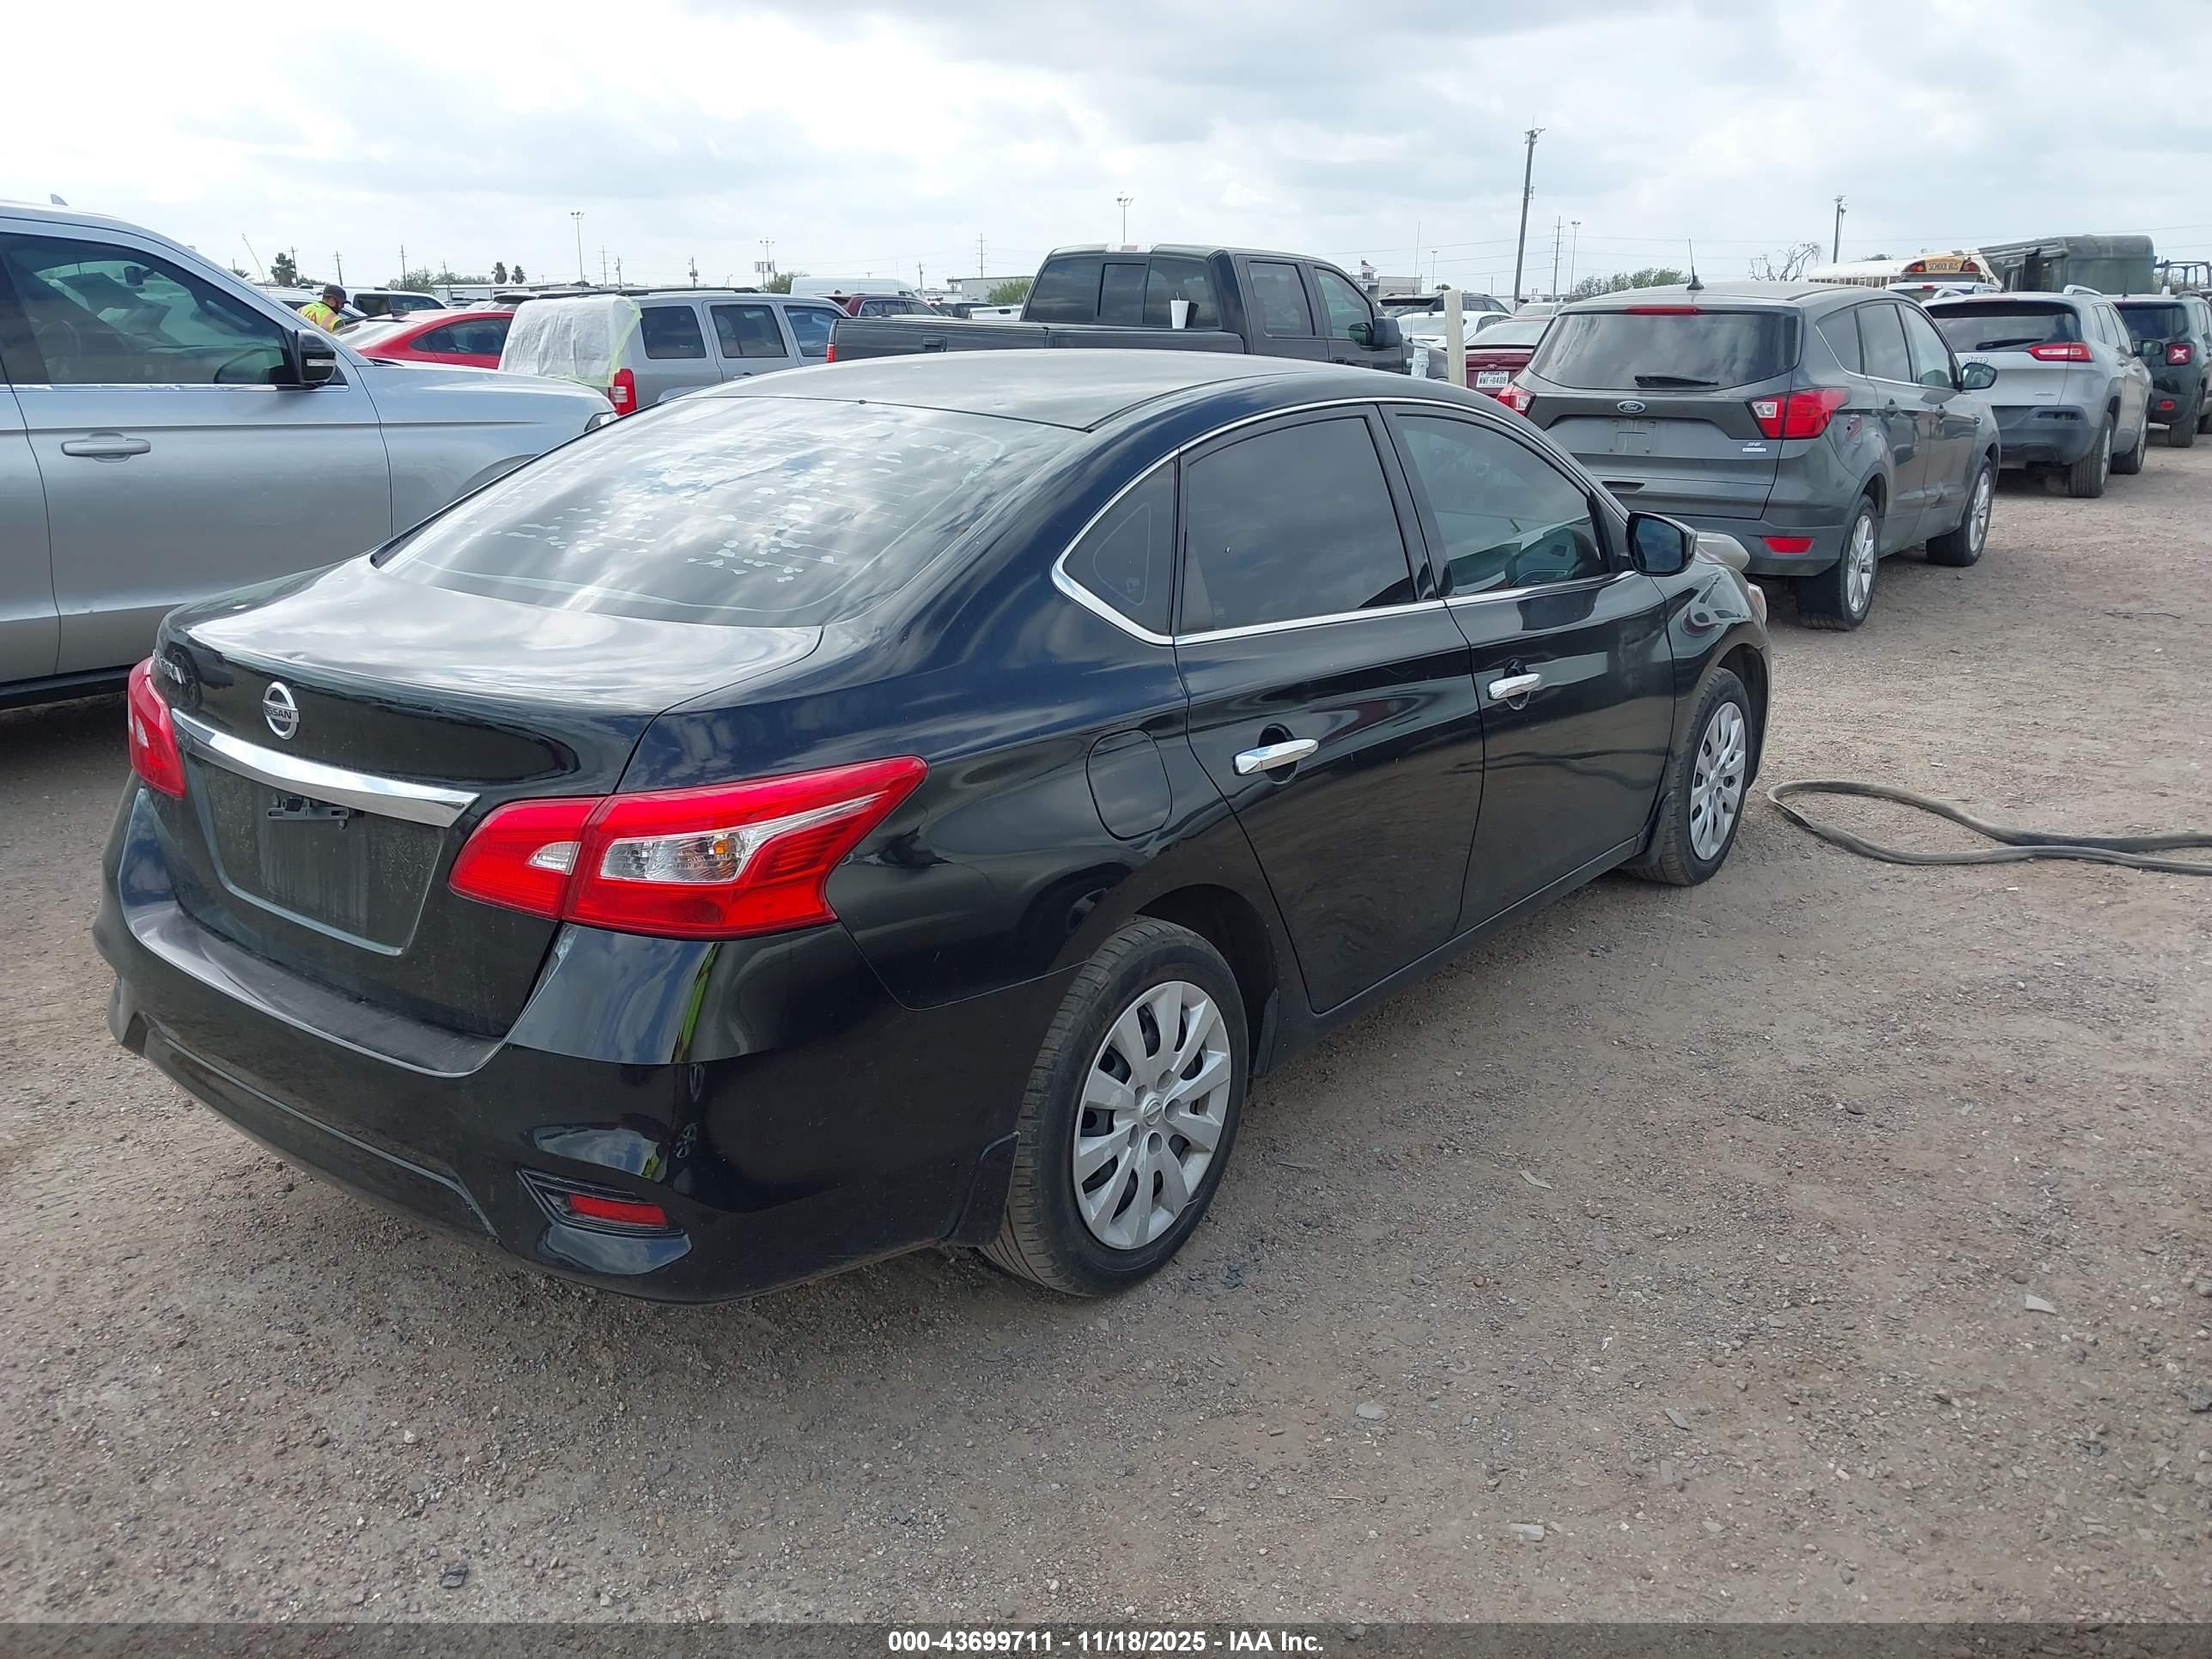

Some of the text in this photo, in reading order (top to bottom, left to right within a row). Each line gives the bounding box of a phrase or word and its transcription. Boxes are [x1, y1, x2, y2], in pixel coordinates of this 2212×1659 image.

[1929, 261, 1959, 270] SCHOOL BUS
[265, 706, 292, 719] SSAN
